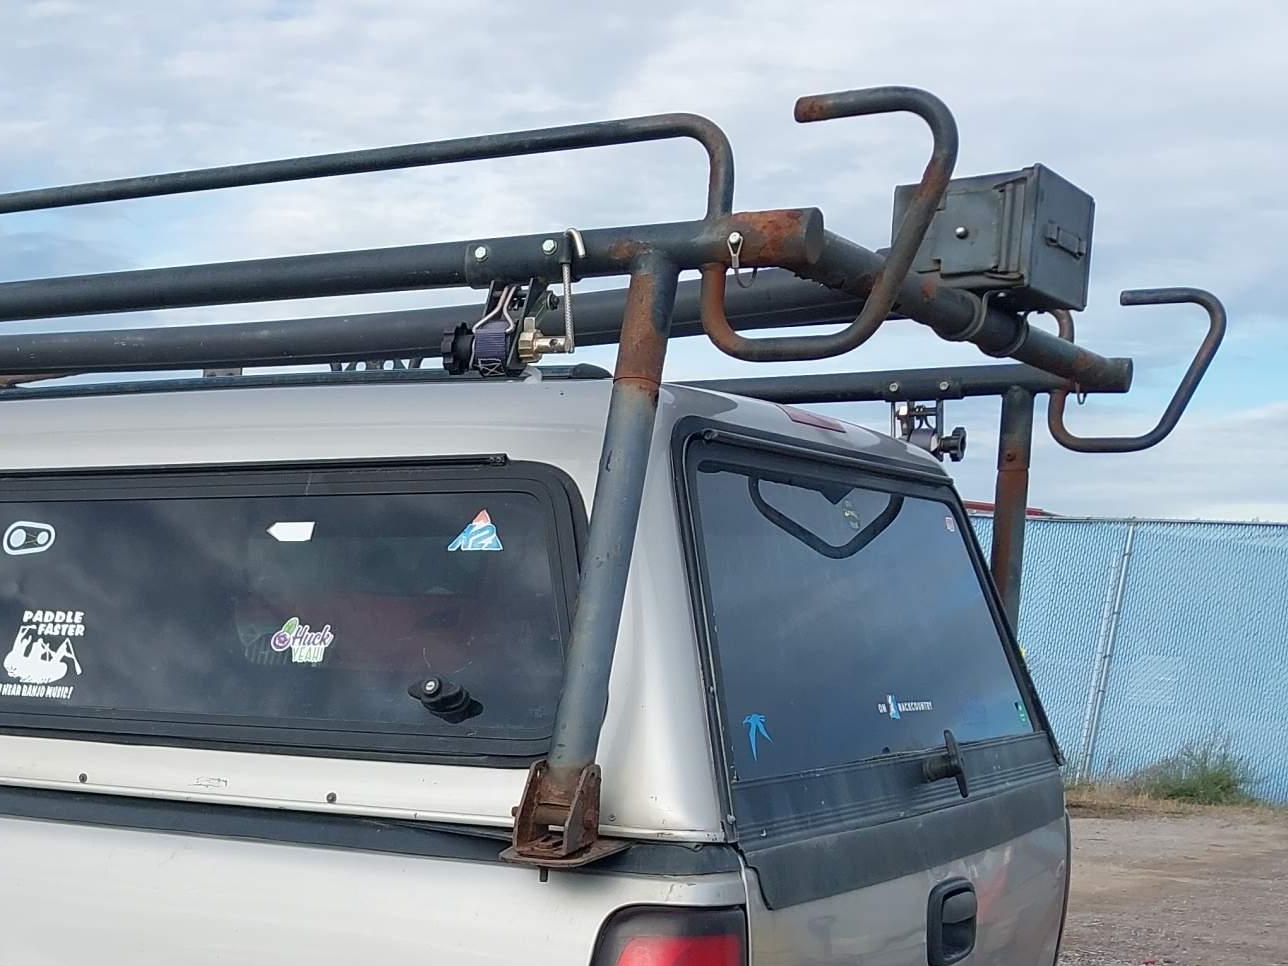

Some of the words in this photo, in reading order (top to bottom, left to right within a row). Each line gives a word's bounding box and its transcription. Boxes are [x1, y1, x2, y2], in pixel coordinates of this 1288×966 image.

[22, 610, 85, 623] PADDLE
[37, 623, 86, 636] FASTER
[292, 625, 333, 647] Huck
